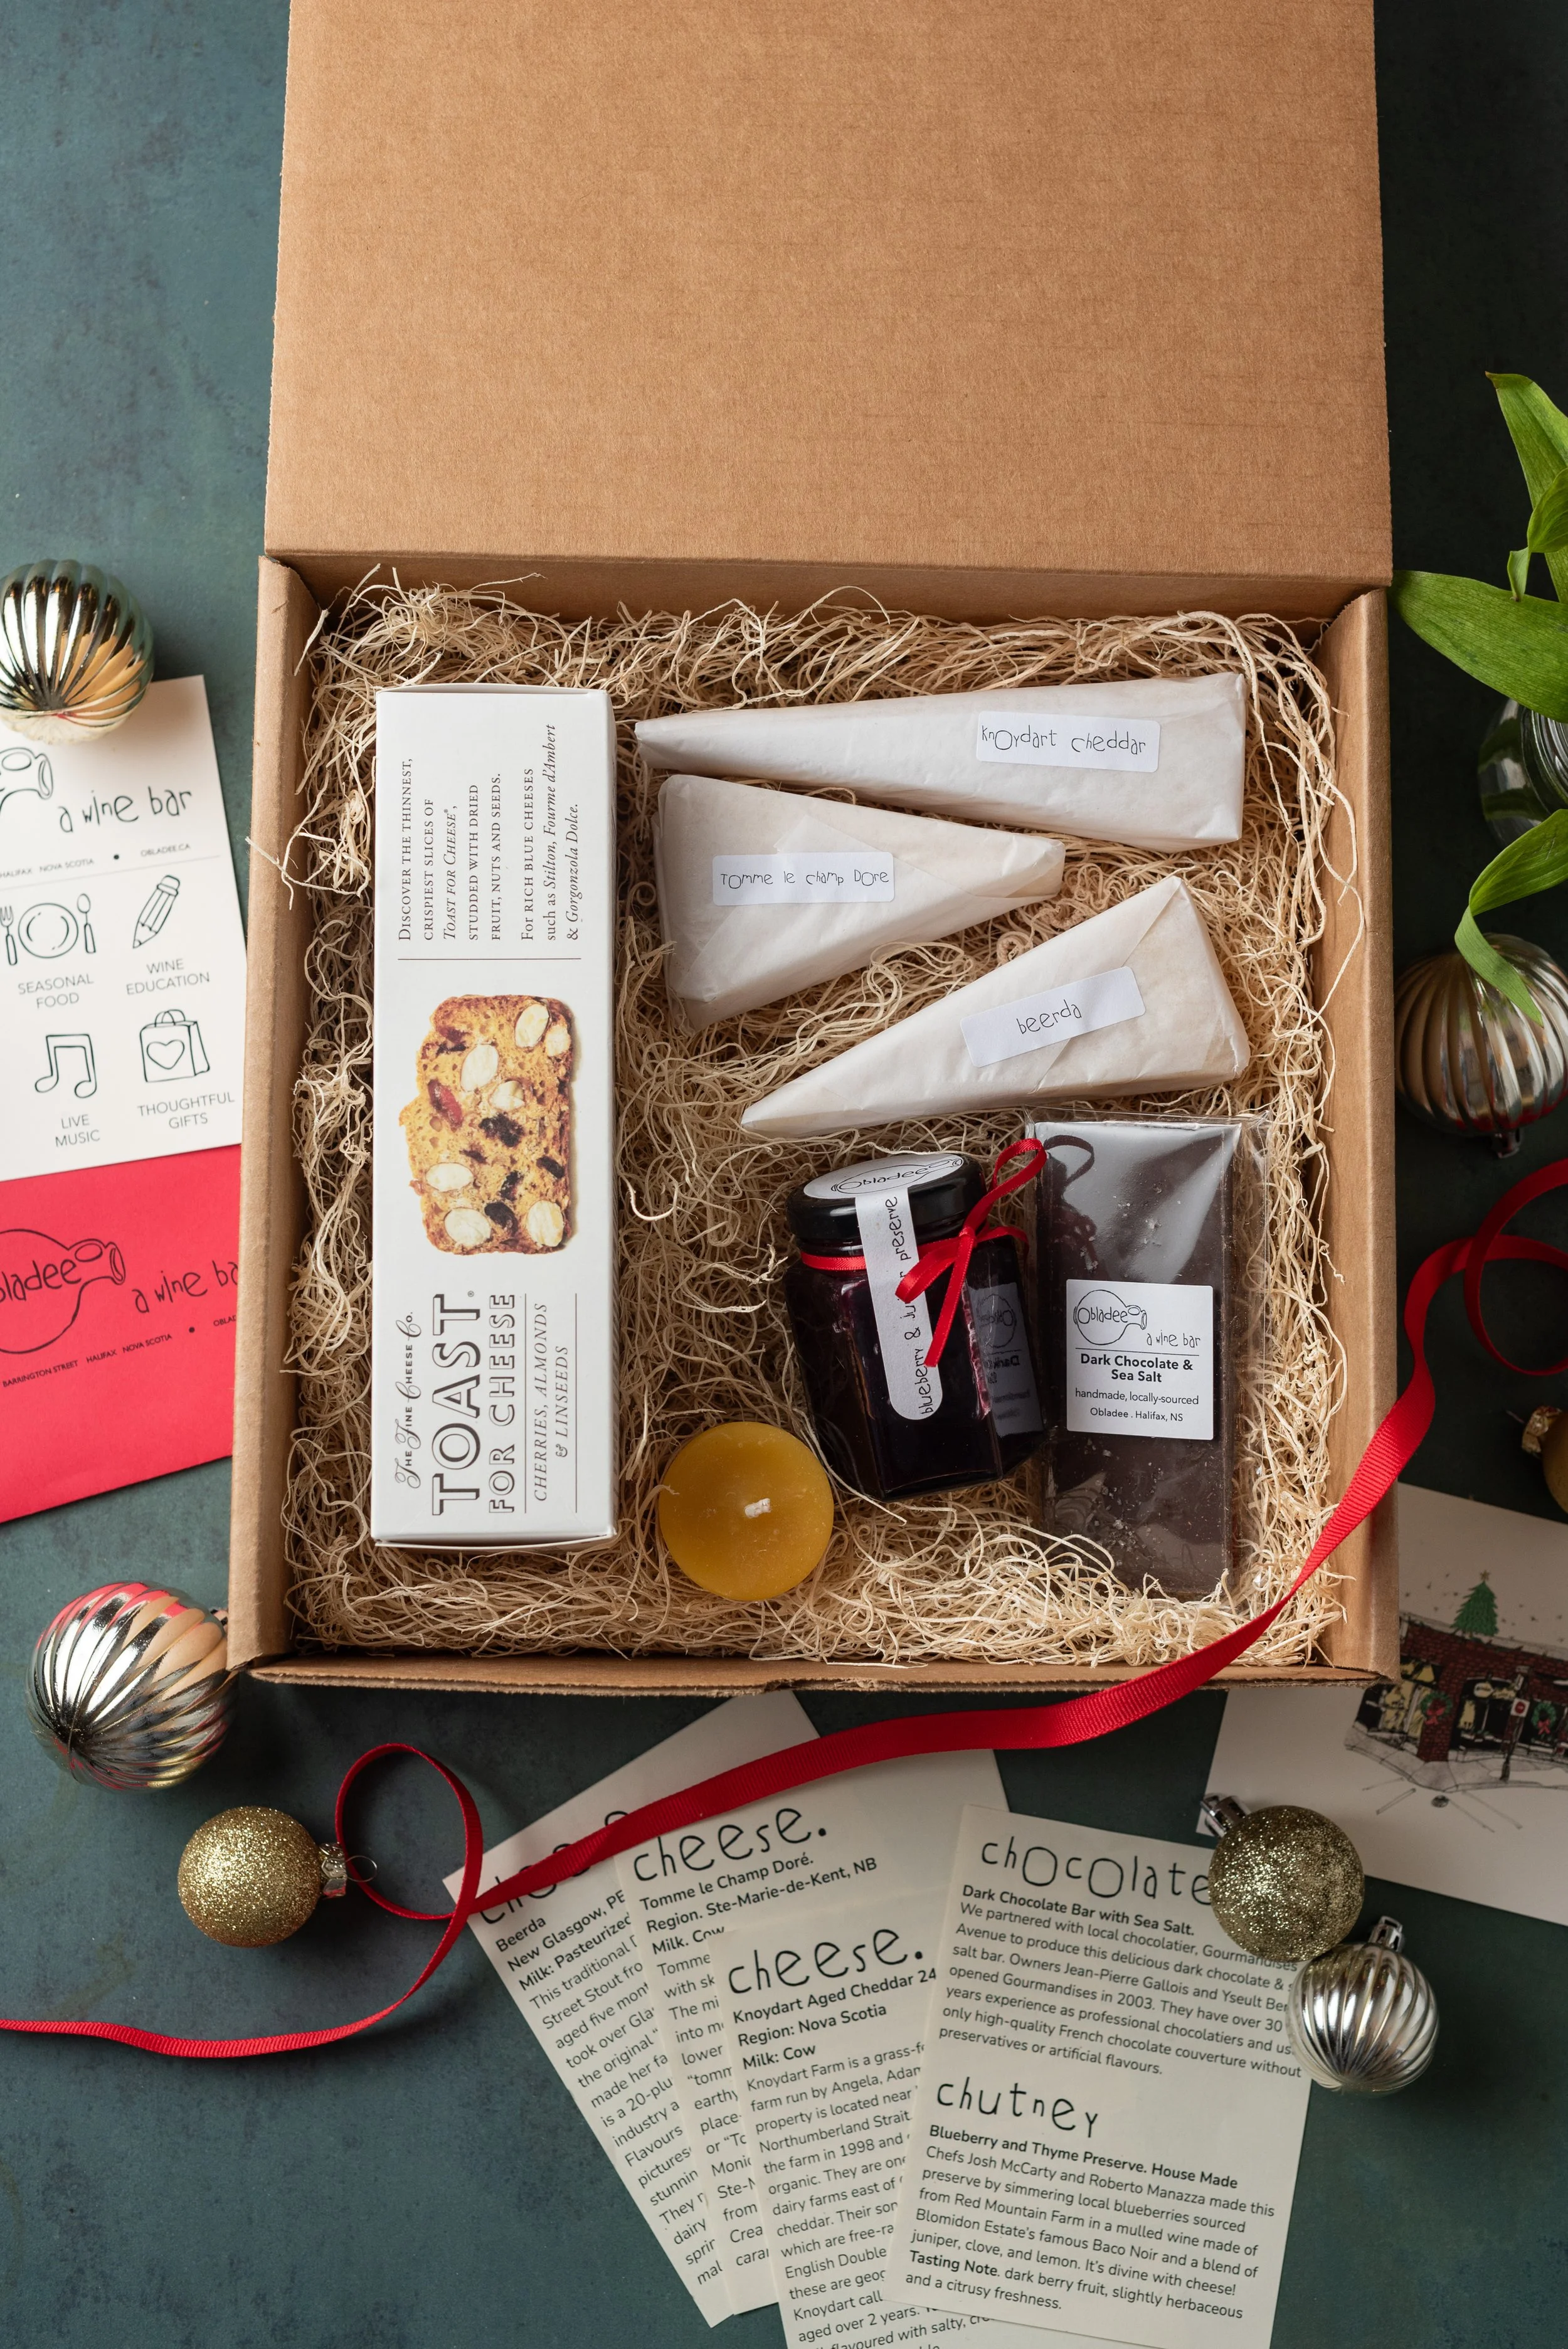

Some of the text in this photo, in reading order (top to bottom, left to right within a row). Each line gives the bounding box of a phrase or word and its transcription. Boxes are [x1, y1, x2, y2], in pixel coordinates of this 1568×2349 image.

[1071, 731, 1146, 755] cheddar
[58, 786, 192, 833] a wine bar
[524, 768, 534, 830] CHEESES
[543, 786, 556, 836] Fourme
[39, 863, 63, 872] NOVA
[65, 858, 94, 868] SCOTIA
[424, 799, 434, 941] CRISPIEST SLICES OF
[469, 785, 479, 941] STUDDED WITH DRIED
[491, 773, 502, 940] FRUIT, NUTS AND SEEDS.
[524, 835, 534, 871] BLUE
[542, 841, 558, 889] Stilton,
[564, 804, 583, 941] & Gorgonzola Dolce.
[524, 877, 534, 913] RICH
[548, 893, 556, 906] as
[783, 871, 795, 884] le
[542, 910, 556, 941] such
[18, 973, 94, 995] SEASONAL
[126, 972, 210, 996] EDUCATION
[146, 958, 184, 973] WINE
[36, 992, 80, 1009] FOOD
[1016, 999, 1082, 1034] beerda
[61, 1114, 90, 1129] LIVE
[137, 1091, 235, 1117] THOUGHTFUL
[168, 1113, 208, 1130] GIFTS
[55, 1130, 100, 1147] MUSIC
[839, 1167, 930, 1190] Obladee
[885, 1197, 911, 1261] preserve
[132, 1260, 238, 1313] a wine ba
[904, 1327, 921, 1340] &
[1078, 1307, 1200, 1348] Obladee a wine bar
[3, 1369, 51, 1387] BARRINGTON
[53, 1360, 78, 1373] STREET
[87, 1349, 117, 1363] HALIFAX
[122, 1342, 144, 1353] NOVA
[146, 1334, 172, 1346] SCOTIA
[1081, 1353, 1193, 1370] Dark Chocolate &
[1111, 1369, 1162, 1382] Sea Salt
[489, 1295, 515, 1514] FOR CHEESE
[534, 1303, 549, 1501] CHERRIES, ALMONDS
[556, 1346, 568, 1457] & LINSEEDS
[1075, 1387, 1199, 1405] handmade, locally-sourced
[1090, 1408, 1128, 1418] Obladee
[1135, 1411, 1168, 1421] Halifax,
[1170, 1413, 1183, 1421] NS
[633, 1808, 827, 1881] cheese.
[638, 1851, 814, 1911] Tomme le Champ Doré.
[645, 1857, 877, 1934] Region. Ste-Marie-de-Kent, NB
[962, 1884, 1195, 1936] Dark Chocolate Bar with Sea Salt.
[495, 1917, 547, 1953] Beerda
[506, 1946, 540, 1972] New
[542, 1907, 607, 1949] Glasgow,
[652, 1936, 689, 1955] Milk.
[518, 1965, 554, 1991] Milk:
[529, 1941, 631, 2009] This traditional
[728, 1928, 923, 1994] cheese.
[733, 1967, 937, 2024] Knoydart Aged Cheddar 24
[737, 2003, 887, 2047] Region: Nova Scotia
[742, 2045, 816, 2071] Milk: Cow
[938, 2028, 1162, 2075] preservatives or artificial flavours.
[936, 2077, 1098, 2138] chutney
[929, 2124, 1238, 2189] Blueberry and Thyme Preserve. House Made
[926, 2145, 1275, 2217] Chefs Josh McCarty and Roberto Manazza made this
[909, 2249, 1243, 2319] Tasting Note. dark berry fruit, slightly herbaceous
